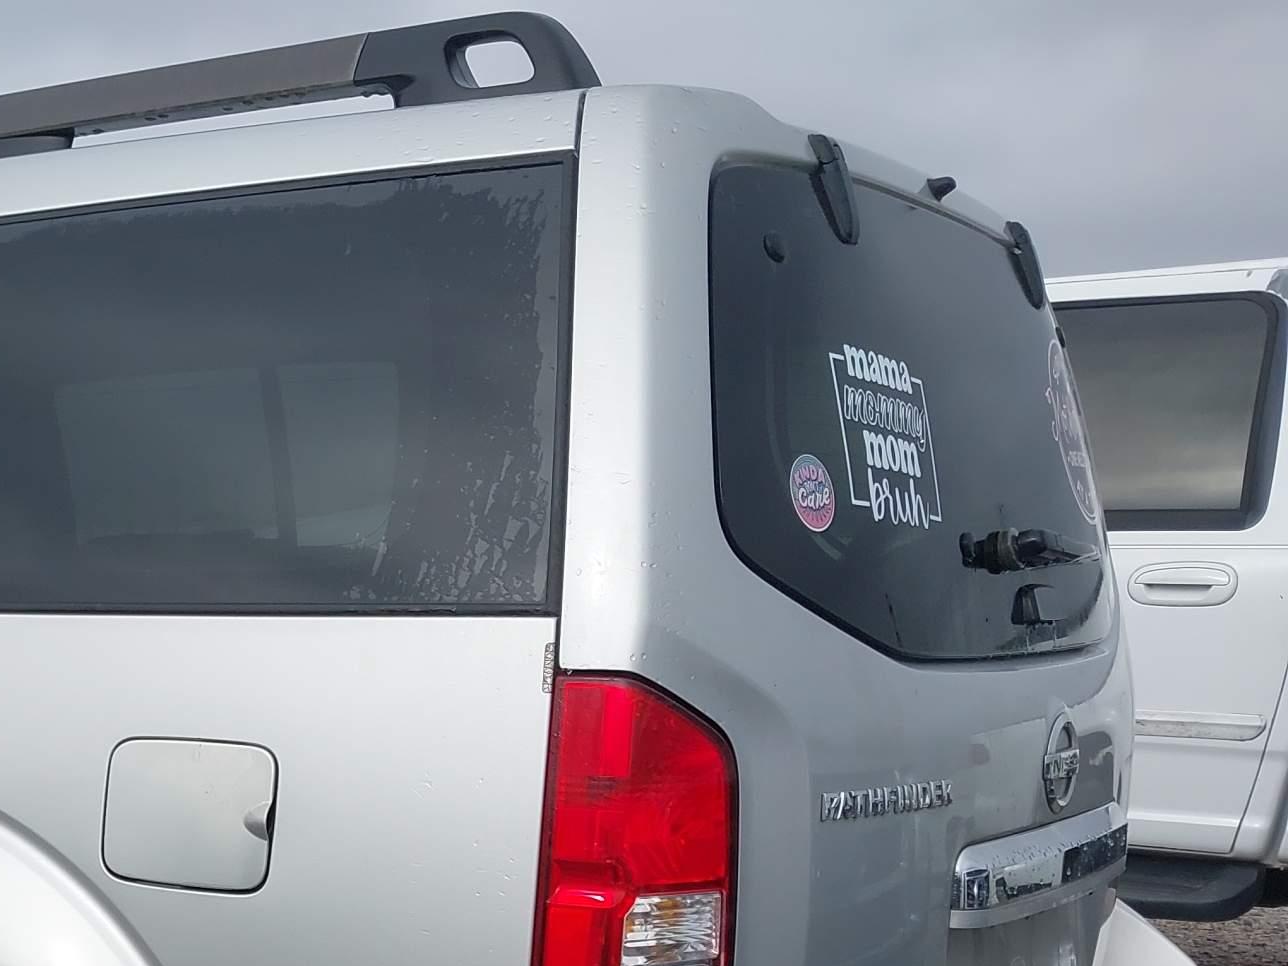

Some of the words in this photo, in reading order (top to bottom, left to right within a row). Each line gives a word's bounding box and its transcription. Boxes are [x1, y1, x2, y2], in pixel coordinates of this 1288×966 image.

[843, 344, 913, 394] mama
[843, 385, 927, 452] mommy
[863, 430, 921, 478] mom
[867, 467, 930, 530] bruh
[820, 780, 952, 821] PATHFINDER
